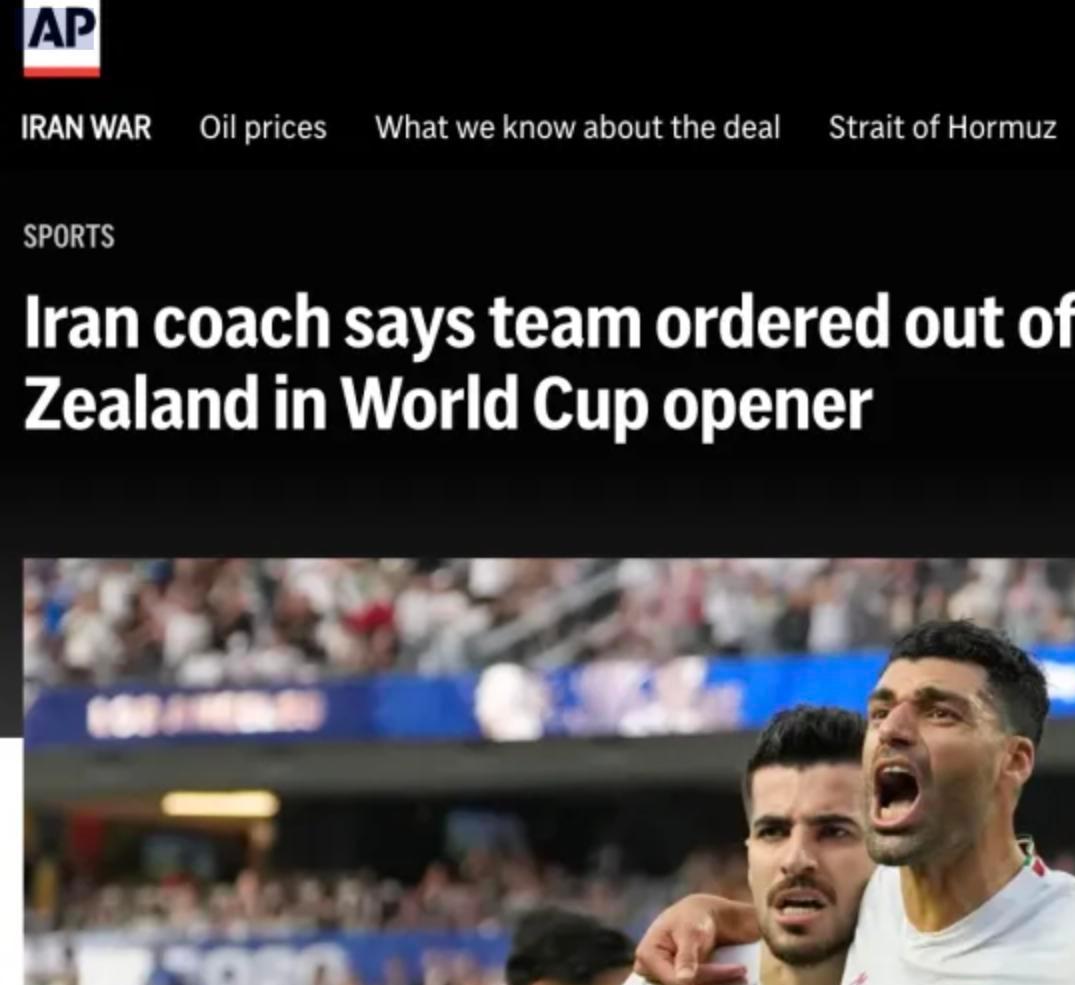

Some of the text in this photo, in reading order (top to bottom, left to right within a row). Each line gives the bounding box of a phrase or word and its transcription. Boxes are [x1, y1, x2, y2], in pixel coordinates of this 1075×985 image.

[28, 6, 96, 48] AP
[22, 114, 151, 139] IRAN WAR
[200, 114, 326, 145] Oil prices
[376, 114, 779, 139] What we know about the deal
[830, 114, 1056, 139] Strait of Hormuz
[24, 224, 114, 248] SPORTS
[27, 295, 138, 348] Iran
[154, 292, 329, 348] coach
[345, 306, 475, 363] says
[488, 297, 640, 348] team
[656, 292, 889, 348] ordered
[905, 297, 1004, 348] out
[25, 374, 873, 444] Zealand in World Cup opener
